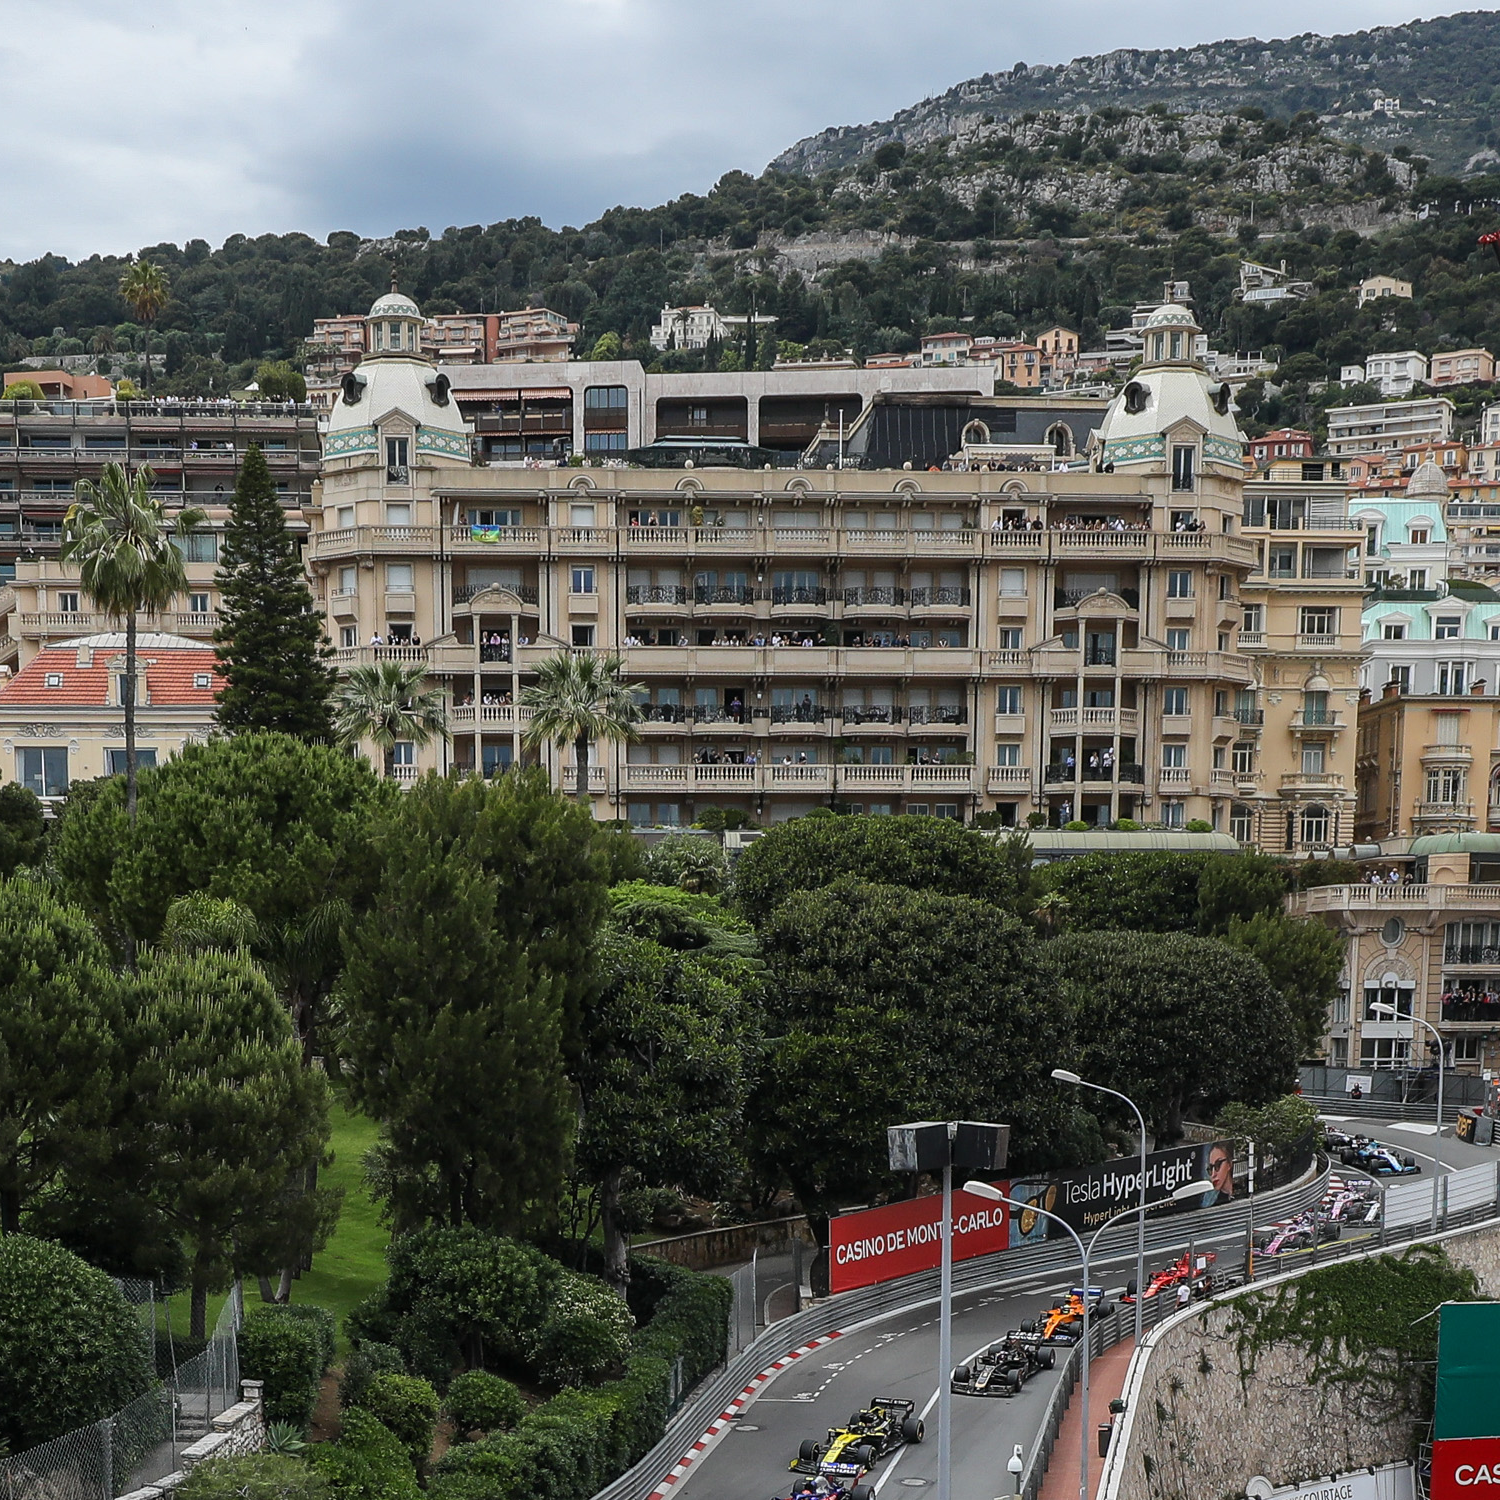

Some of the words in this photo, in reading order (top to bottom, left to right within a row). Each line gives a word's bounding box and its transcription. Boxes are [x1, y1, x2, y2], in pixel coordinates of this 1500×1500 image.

[1062, 1174, 1100, 1205] Tesla
[1102, 1157, 1193, 1201] HyperLight
[836, 1235, 885, 1266] CASINO
[887, 1230, 906, 1251] DE
[907, 1206, 1004, 1248] MONT-CARLO
